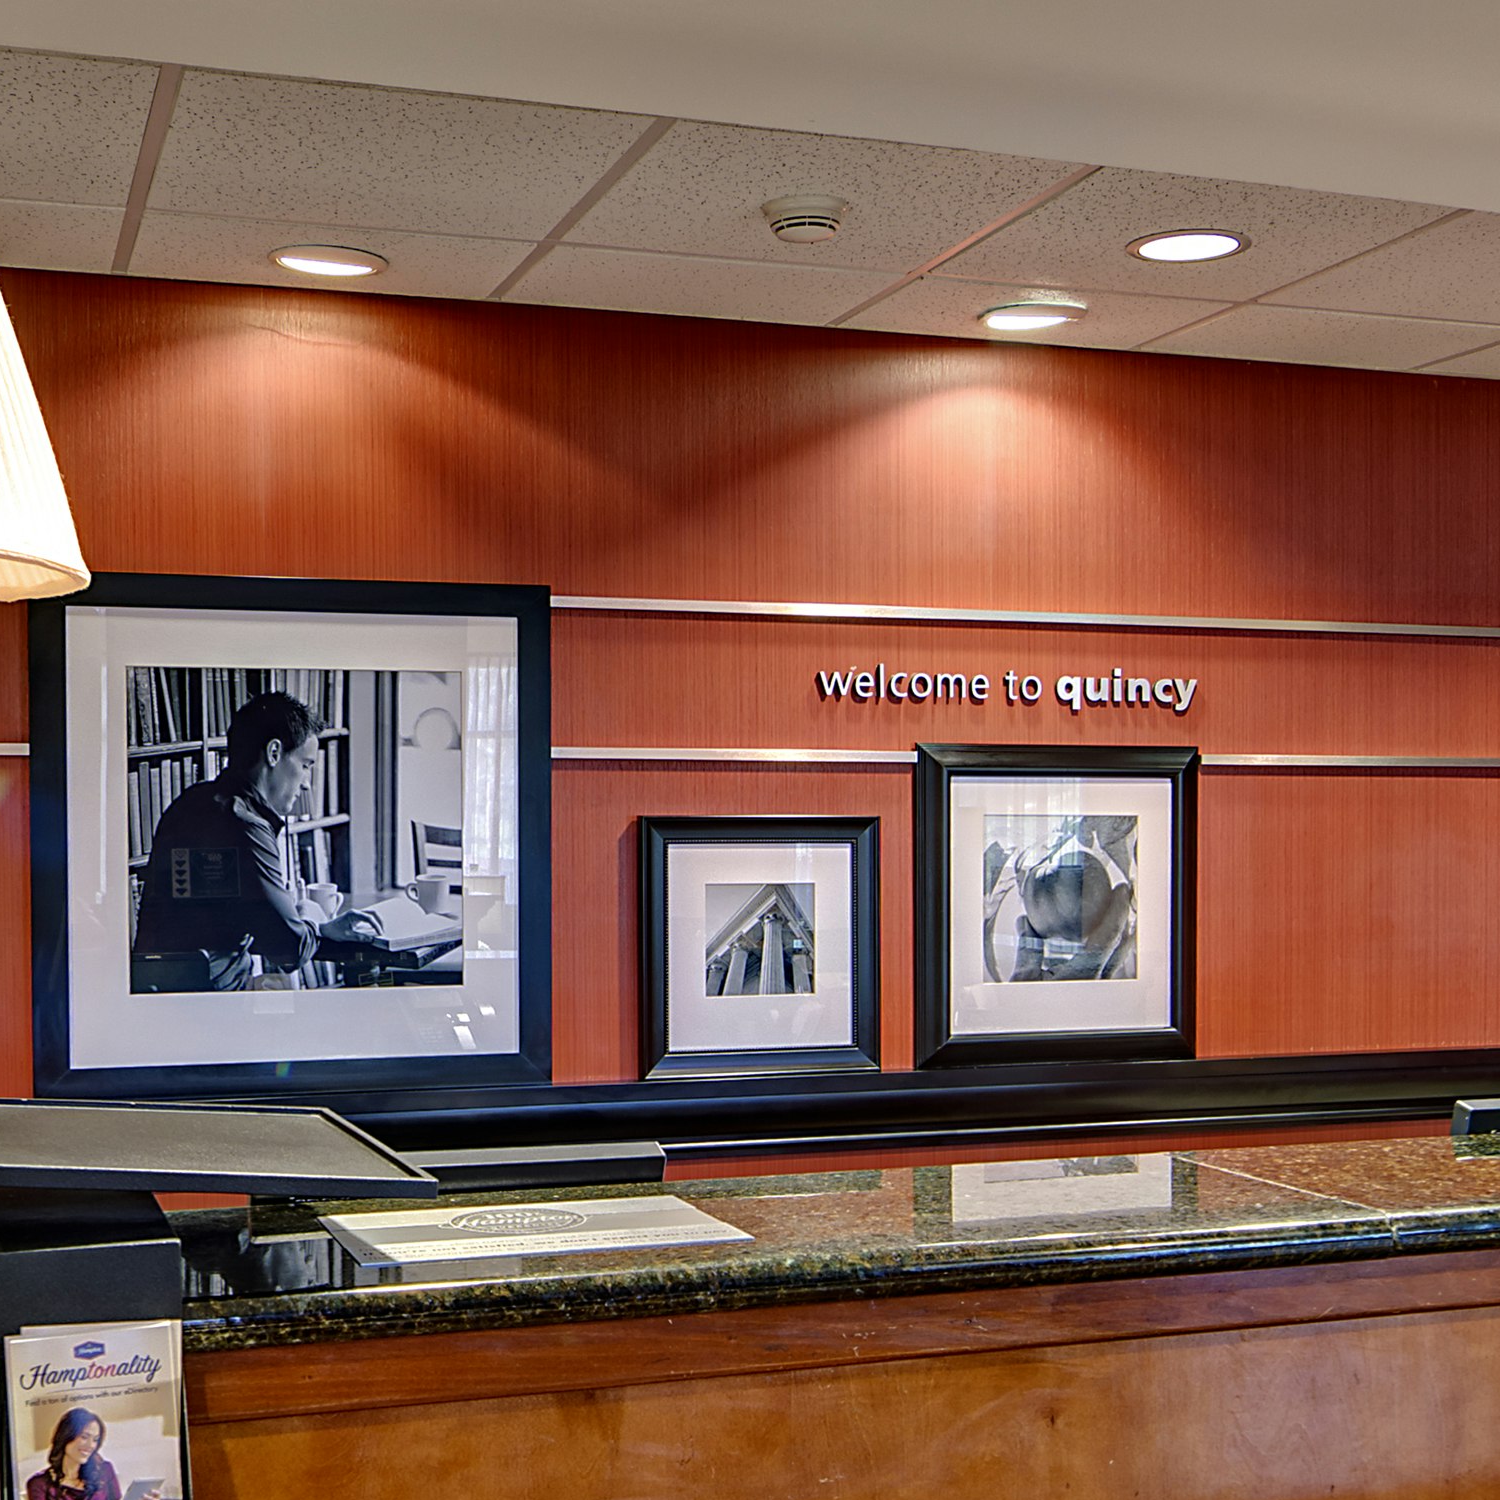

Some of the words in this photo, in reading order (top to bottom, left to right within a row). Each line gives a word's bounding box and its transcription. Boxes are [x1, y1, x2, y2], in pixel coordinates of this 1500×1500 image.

[817, 664, 990, 699] welcome
[1004, 669, 1042, 701] to
[1055, 667, 1198, 711] quincy
[20, 1354, 161, 1390] Hamptonality
